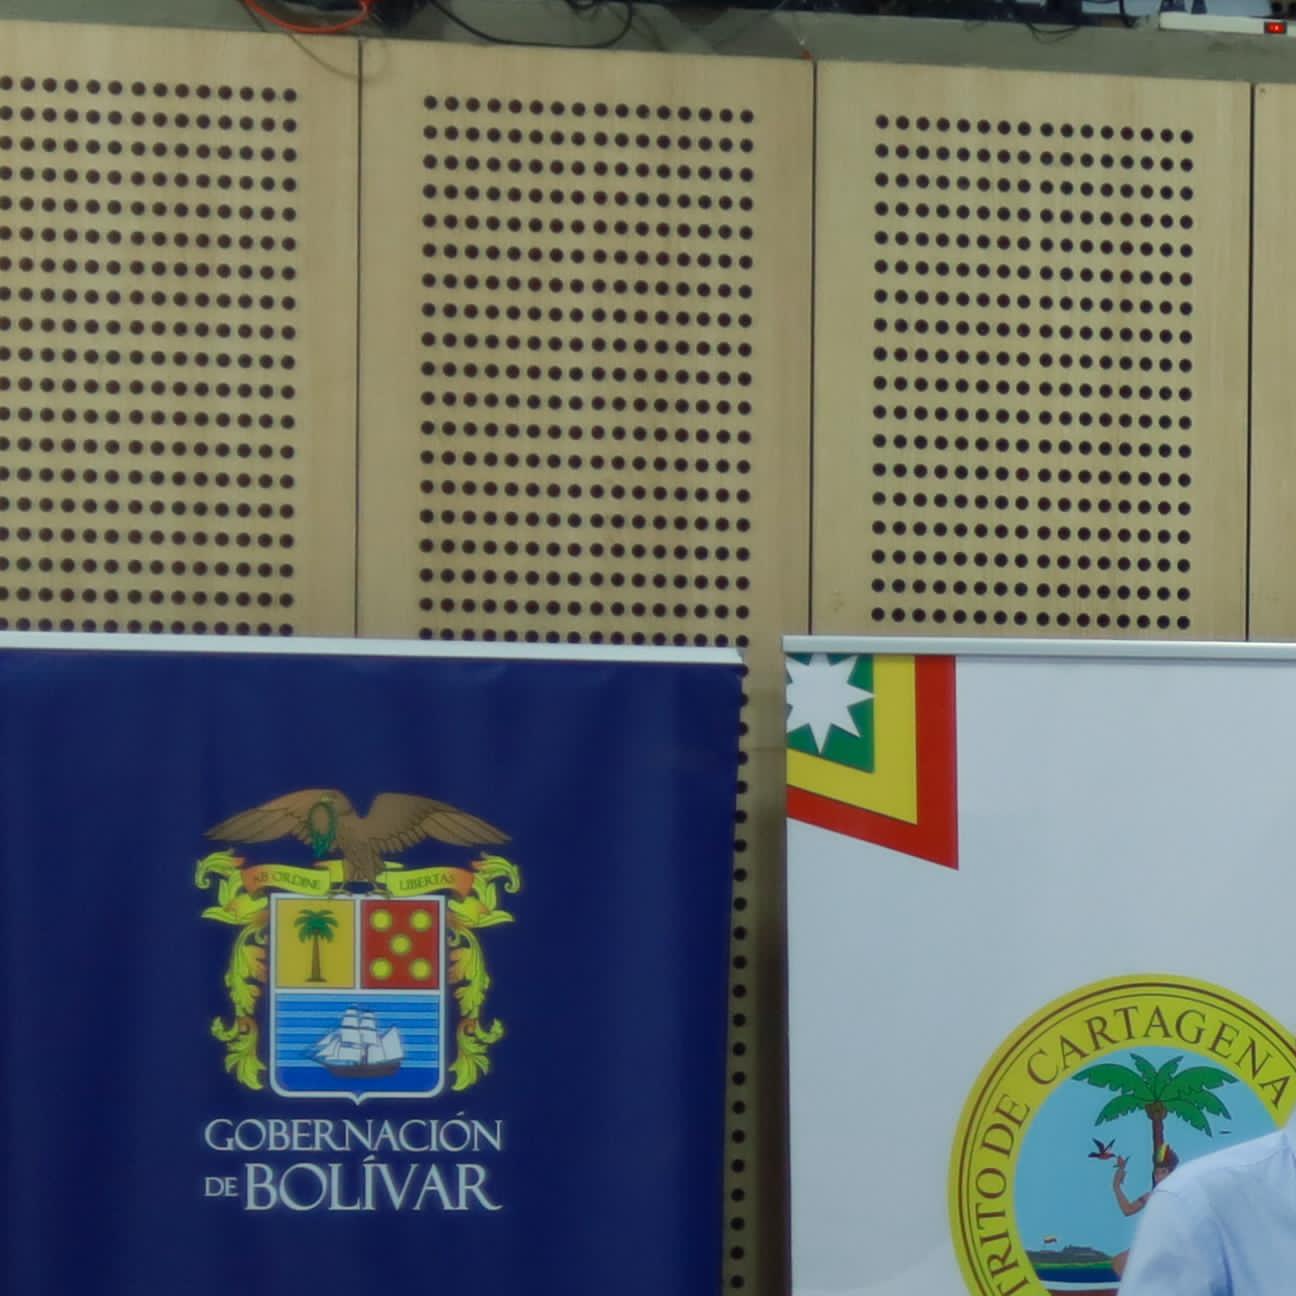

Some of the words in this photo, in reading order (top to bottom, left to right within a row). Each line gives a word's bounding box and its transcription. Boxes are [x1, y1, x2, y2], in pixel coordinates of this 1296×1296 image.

[271, 870, 321, 890] ORDINE
[399, 870, 456, 890] LIBERTAS
[979, 1092, 1031, 1158] DE
[1026, 1004, 1292, 1110] CARTAGENA
[204, 1111, 503, 1151] GOBERNACIÓN
[204, 1176, 239, 1197] DE
[244, 1154, 504, 1211] BOLÍVAR
